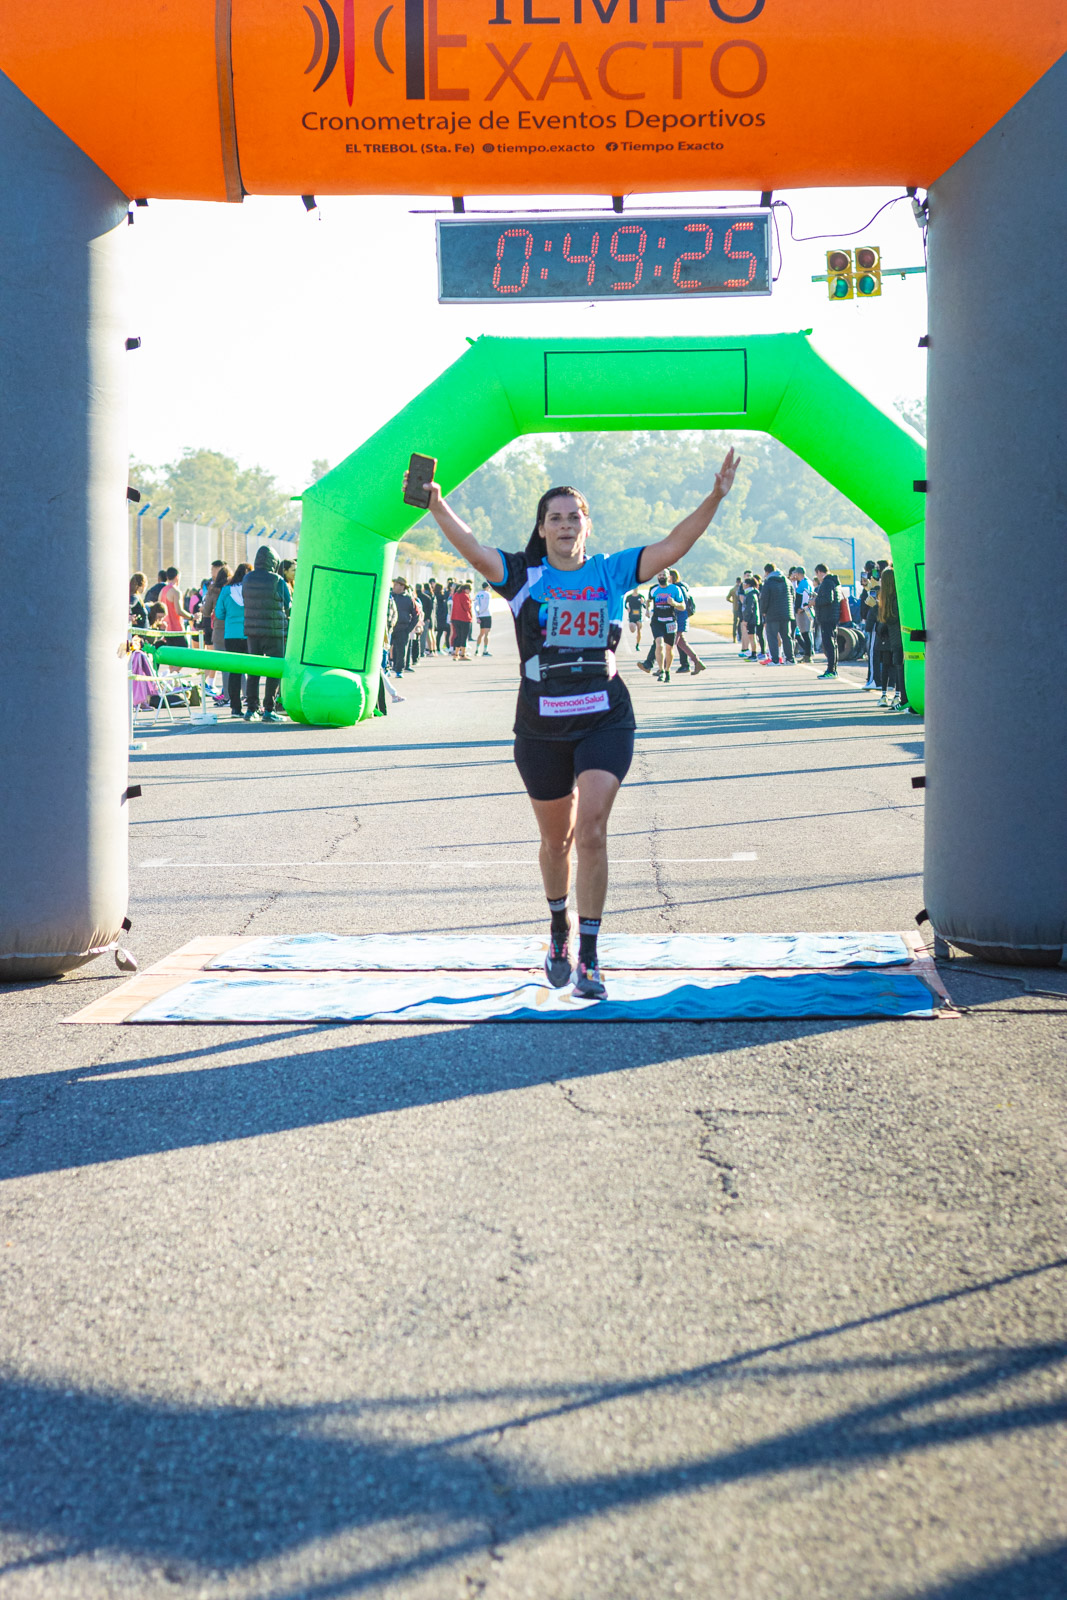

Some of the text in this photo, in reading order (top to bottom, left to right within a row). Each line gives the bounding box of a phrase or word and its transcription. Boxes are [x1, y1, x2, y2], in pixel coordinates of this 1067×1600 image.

[301, 109, 766, 135] Cronometraje de Eventos Deportivos
[345, 143, 362, 153] EL
[364, 143, 417, 154] TREBOL
[421, 143, 451, 154] (Sta.
[454, 143, 475, 154] Fe)
[620, 141, 674, 153] Tiempo
[678, 140, 724, 151] Exacto
[492, 222, 757, 294] 0:49:25
[558, 610, 599, 637] 245
[585, 693, 605, 704] Salud
